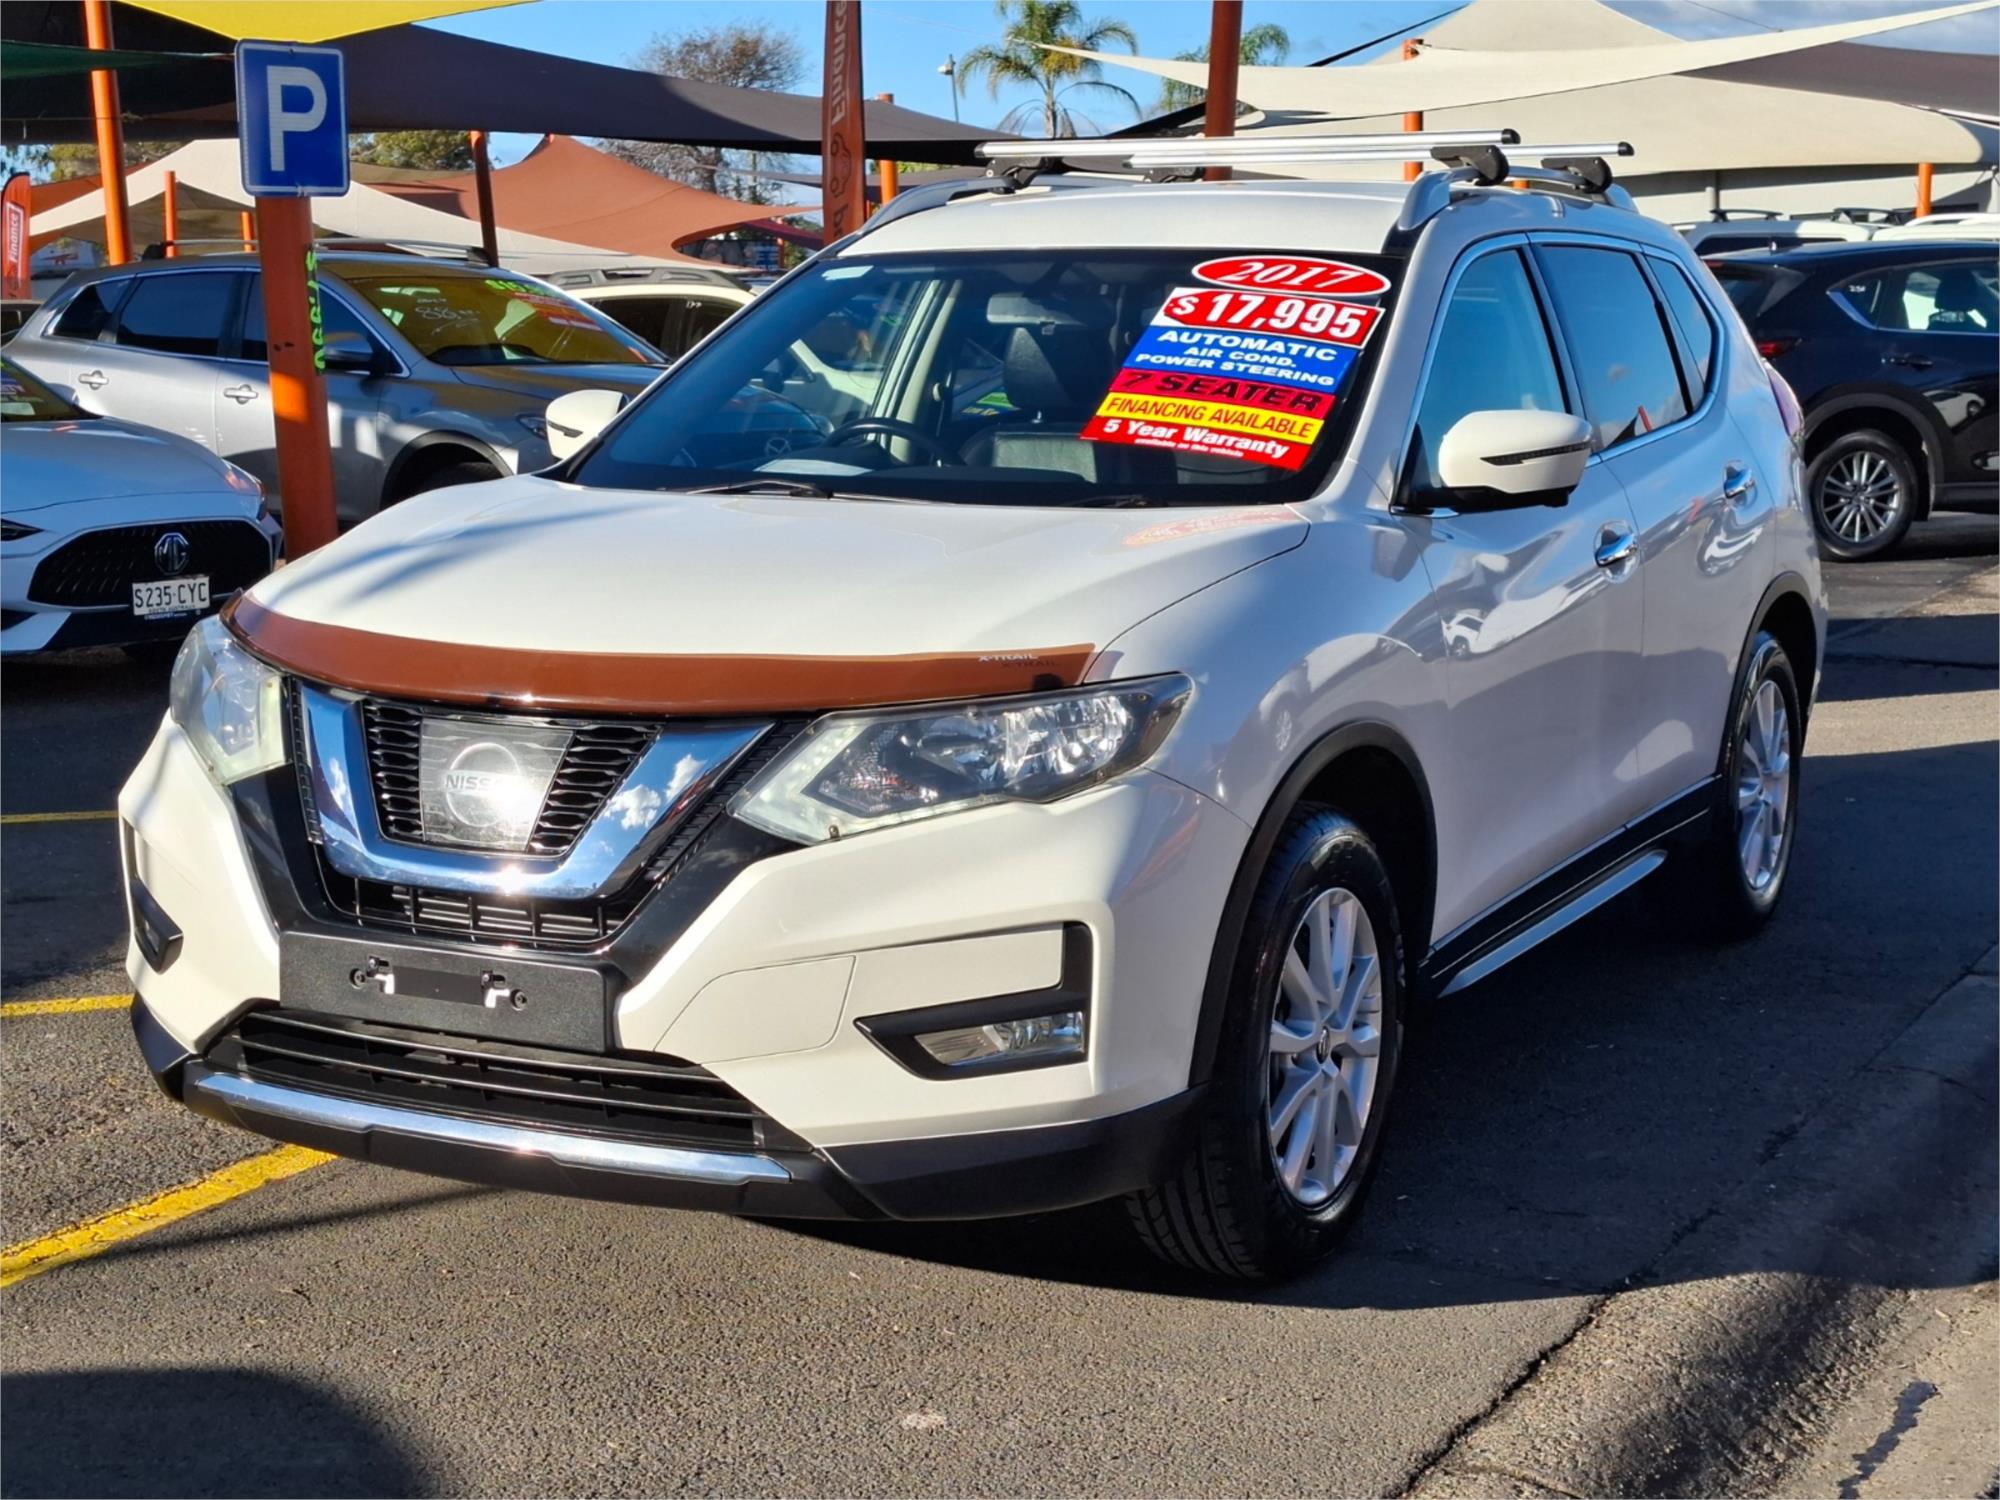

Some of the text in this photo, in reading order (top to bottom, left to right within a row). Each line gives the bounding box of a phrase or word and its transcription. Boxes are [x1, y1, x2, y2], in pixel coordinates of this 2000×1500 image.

[266, 65, 328, 172] P
[8, 210, 21, 263] Finance
[1216, 261, 1366, 288] 2017
[1206, 293, 1368, 339] 17,995
[1157, 330, 1338, 362] AUTOMATIC
[1184, 346, 1297, 368] AIR COND.
[1136, 353, 1335, 387] POWER STEERING
[1121, 371, 1323, 413] 7 SEATER
[1106, 396, 1314, 439] FINANCING AVAILABLE
[1103, 419, 1290, 459] 5 Year Warranty
[977, 653, 1039, 662] X-TRAIL
